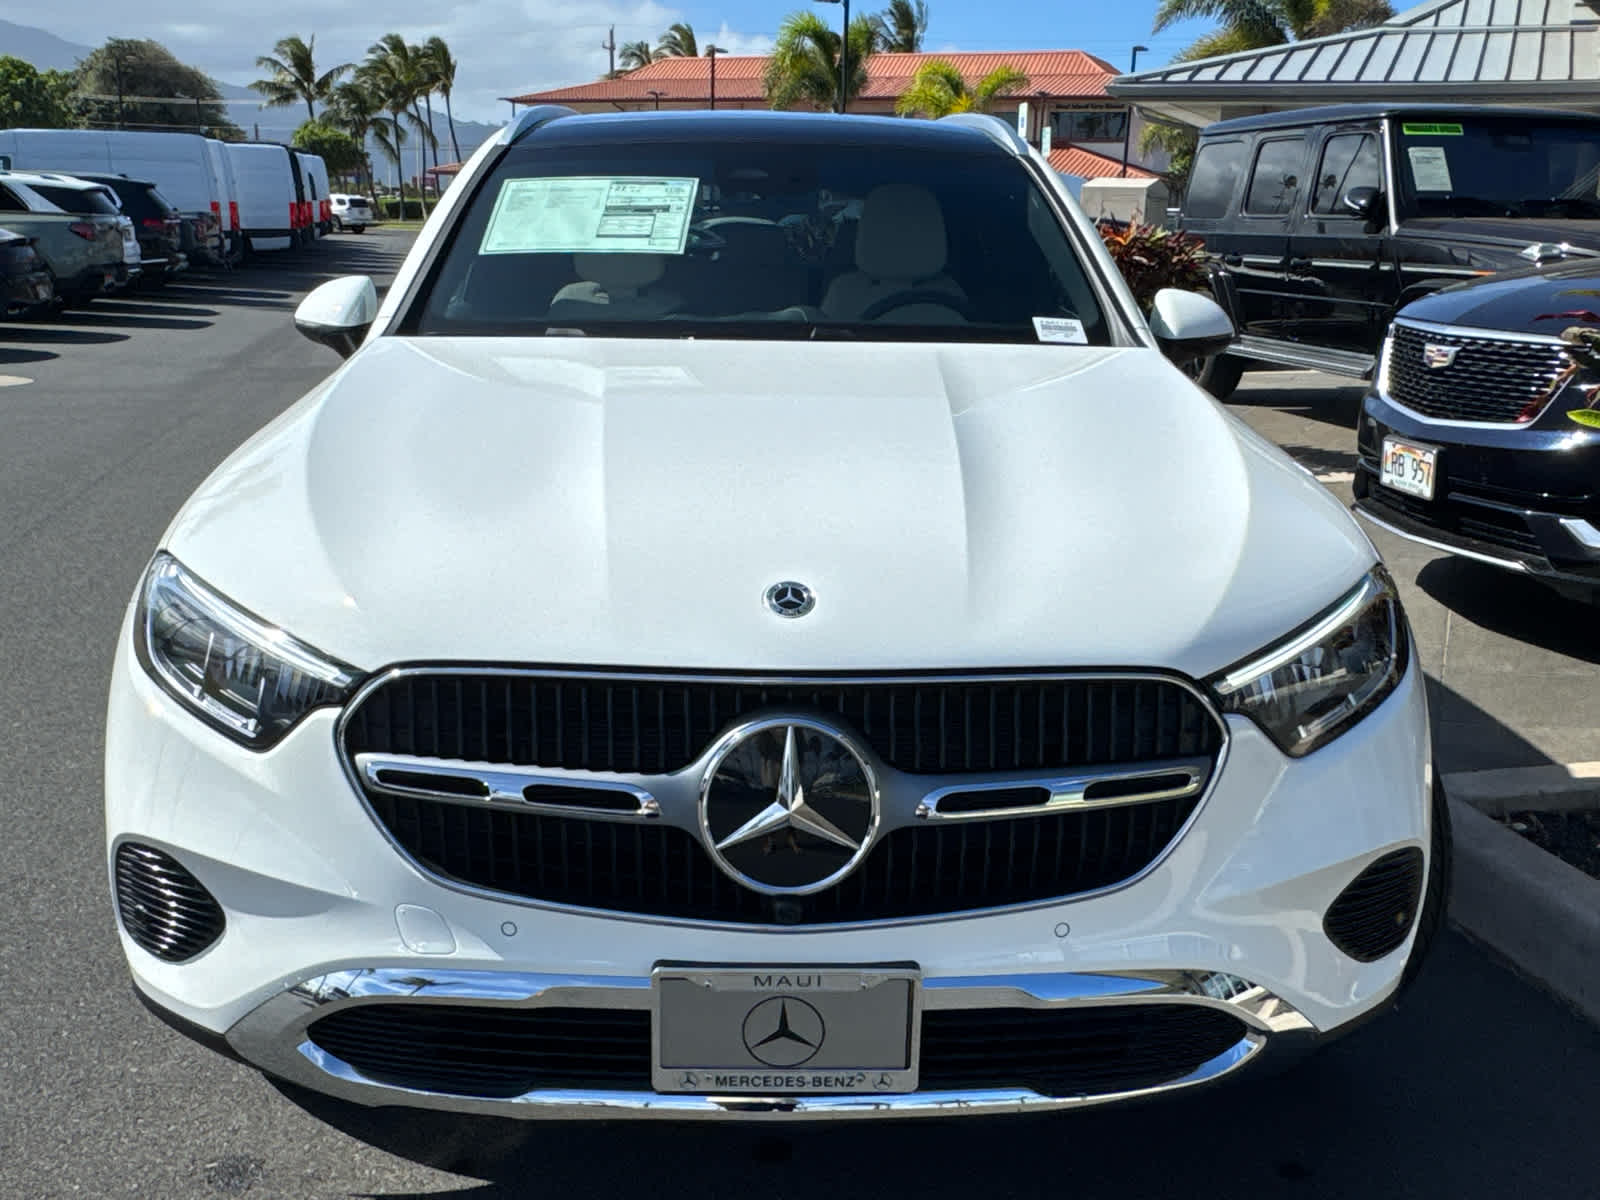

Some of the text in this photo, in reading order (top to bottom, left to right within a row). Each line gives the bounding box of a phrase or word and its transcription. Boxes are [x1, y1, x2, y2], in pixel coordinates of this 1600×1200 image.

[1384, 450, 1432, 488] LRB 957
[753, 974, 822, 988] MAUI
[714, 1074, 856, 1088] MERCEDES-BENZ
